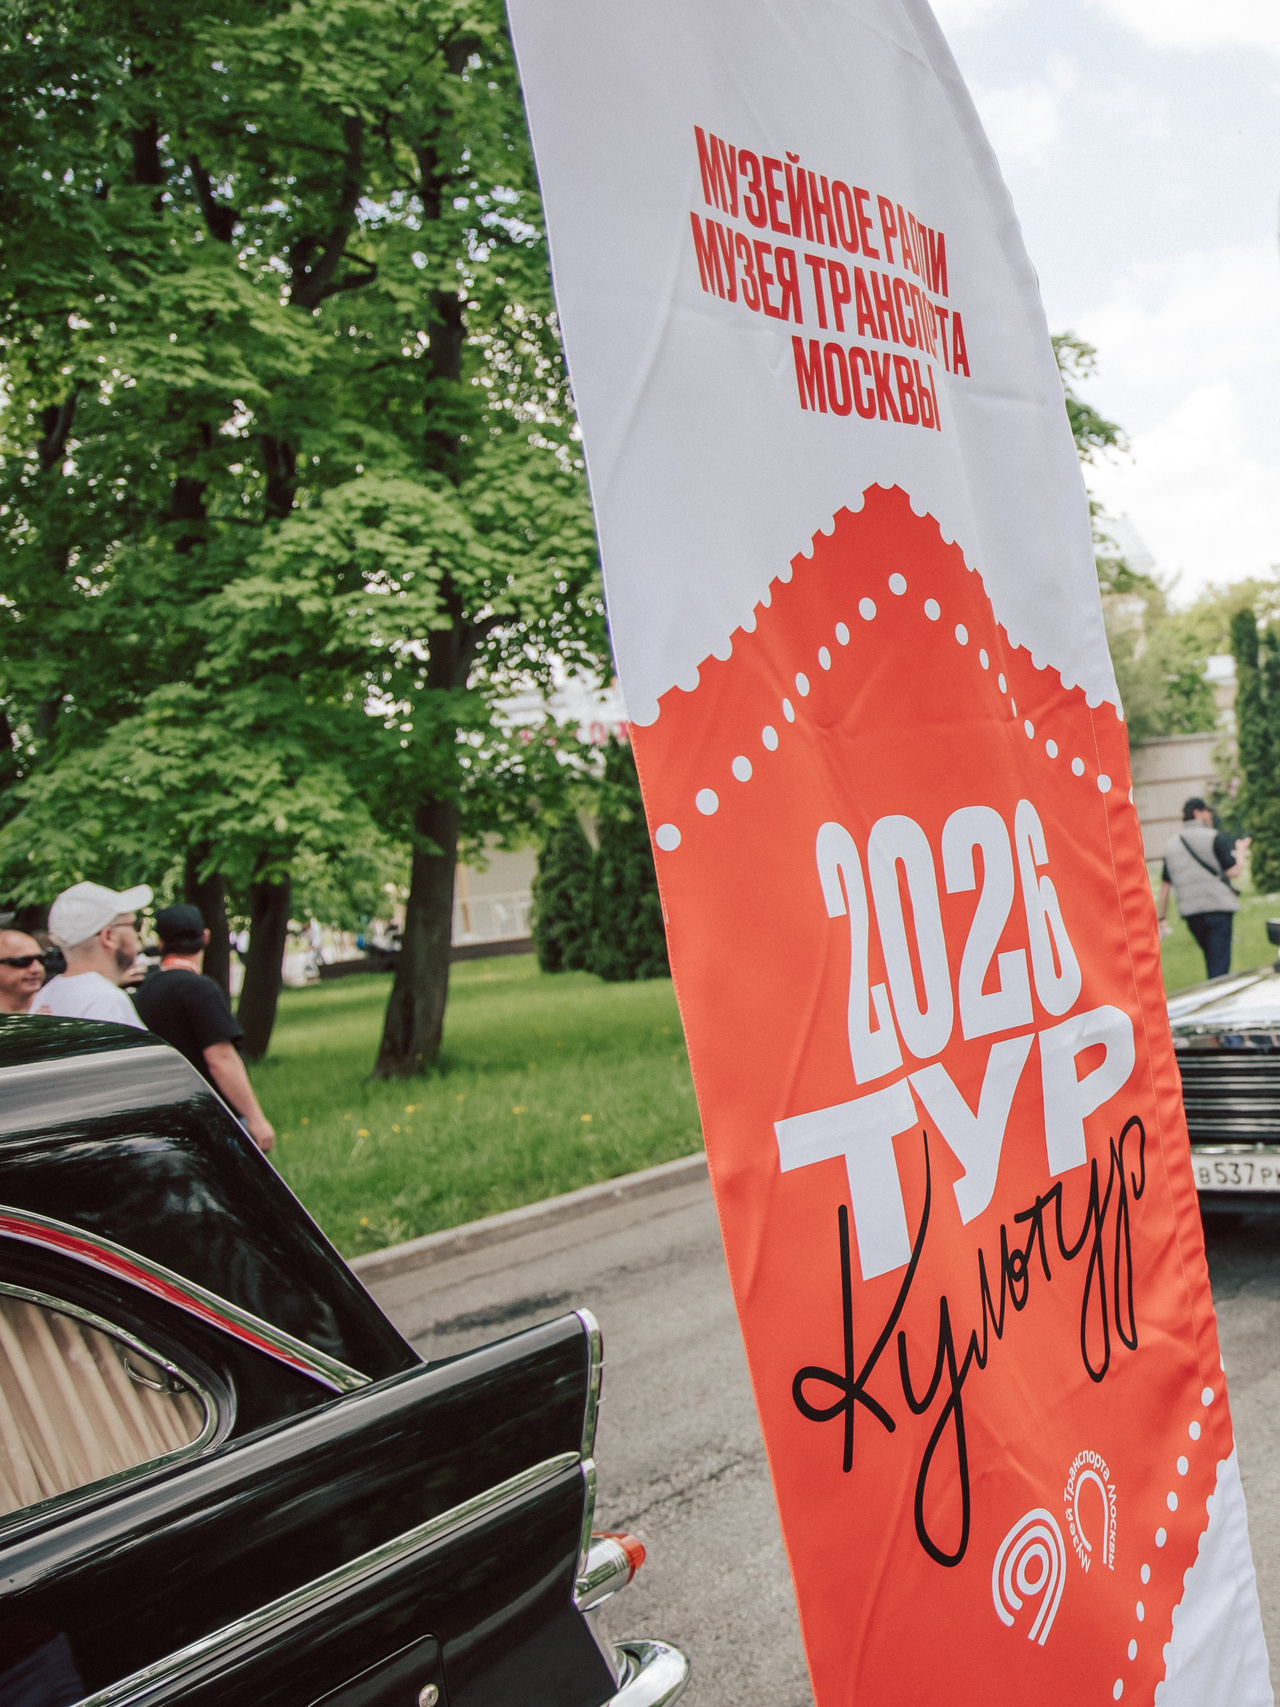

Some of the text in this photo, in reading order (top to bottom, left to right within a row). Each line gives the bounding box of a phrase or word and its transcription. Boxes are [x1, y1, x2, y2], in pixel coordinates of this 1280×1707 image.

[694, 125, 880, 260] МУЗЕЙНОЕ
[690, 211, 971, 378] МУЗЕЯ ТРАНСПОРТА
[791, 335, 942, 432] МОСКВЫ
[816, 799, 1082, 1085] 2026
[774, 1005, 1136, 1282] ТУР
[1065, 1508, 1091, 1573] Музей
[1107, 1484, 1117, 1571] Москвы
